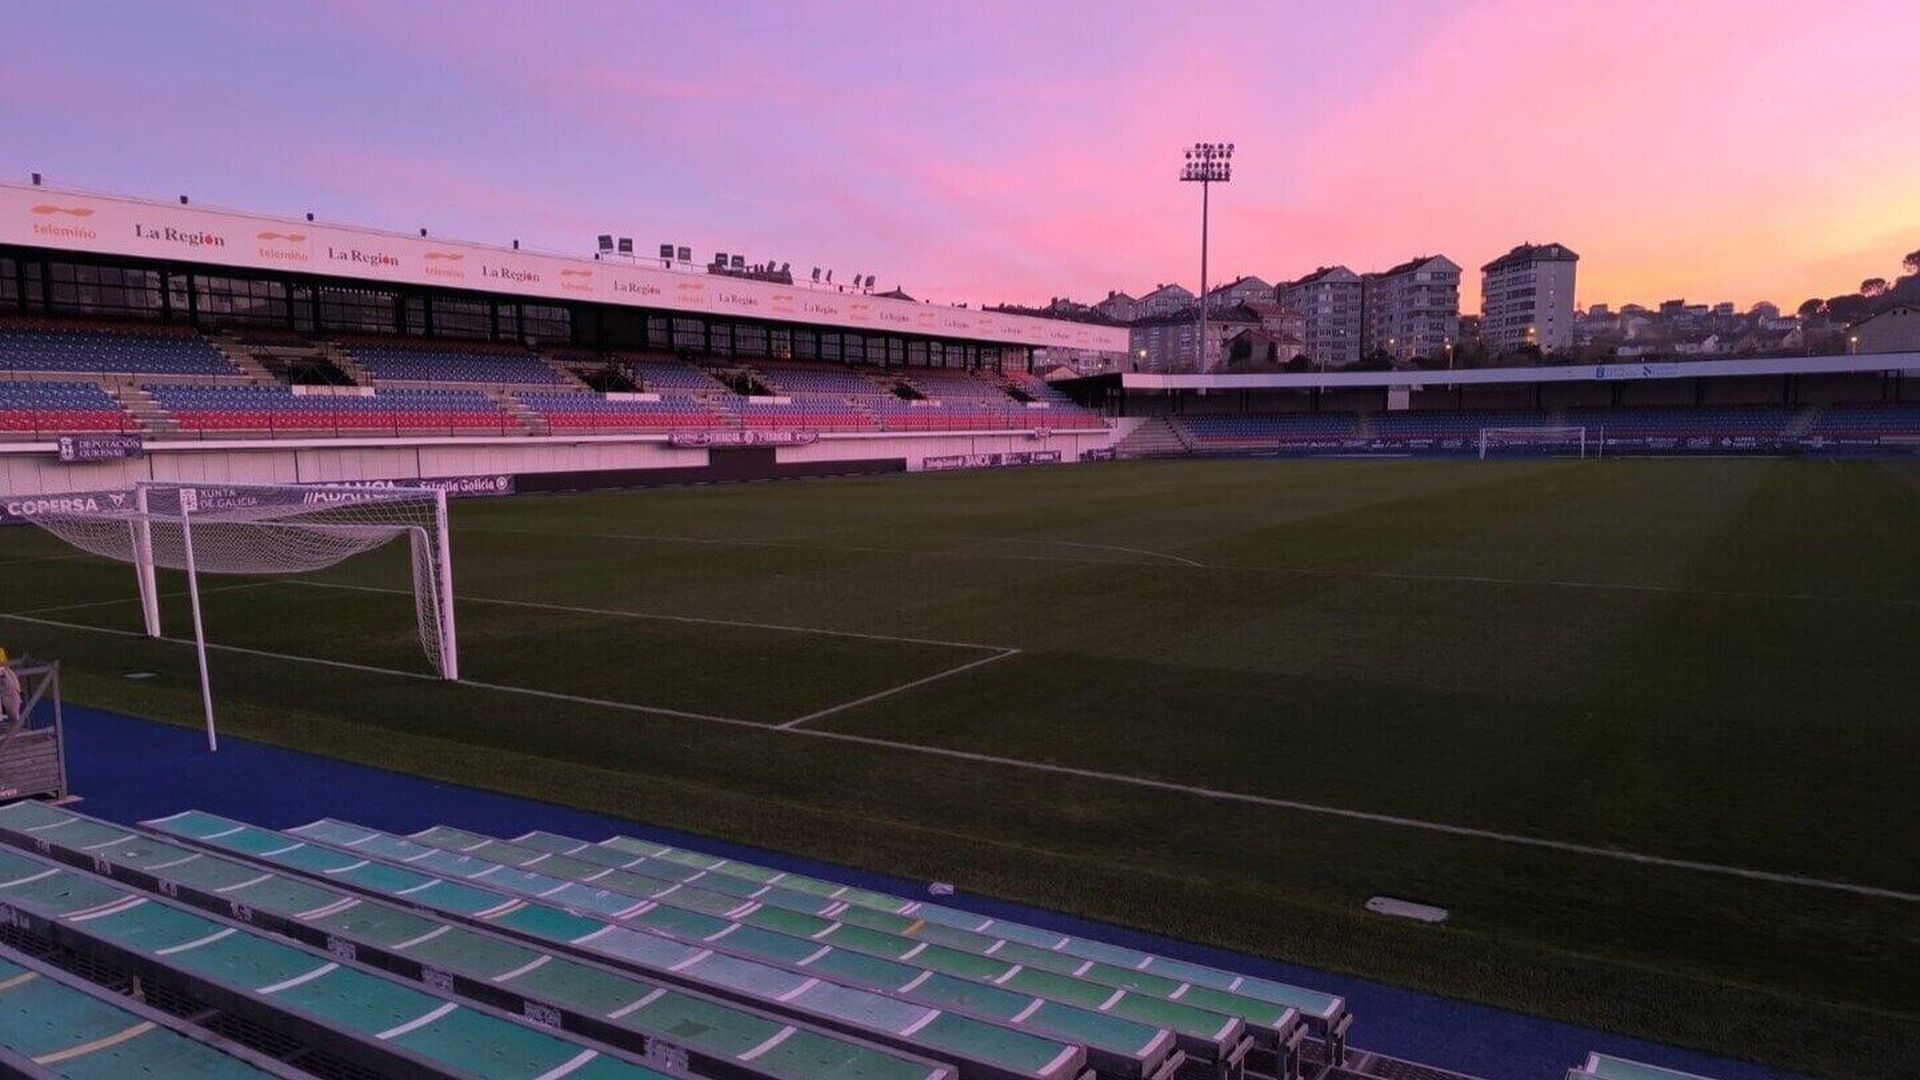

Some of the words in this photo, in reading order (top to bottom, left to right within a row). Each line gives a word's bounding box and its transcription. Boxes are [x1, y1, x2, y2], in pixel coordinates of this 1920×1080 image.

[135, 224, 160, 239] La
[164, 227, 225, 247] Región
[328, 247, 348, 260] La
[351, 250, 399, 266] Región
[482, 265, 499, 277] La
[460, 478, 495, 492] Galicia
[200, 488, 236, 498] XUNTA
[7, 498, 98, 516] COPERSA
[200, 499, 216, 509] DE
[217, 497, 258, 508] GALICIA
